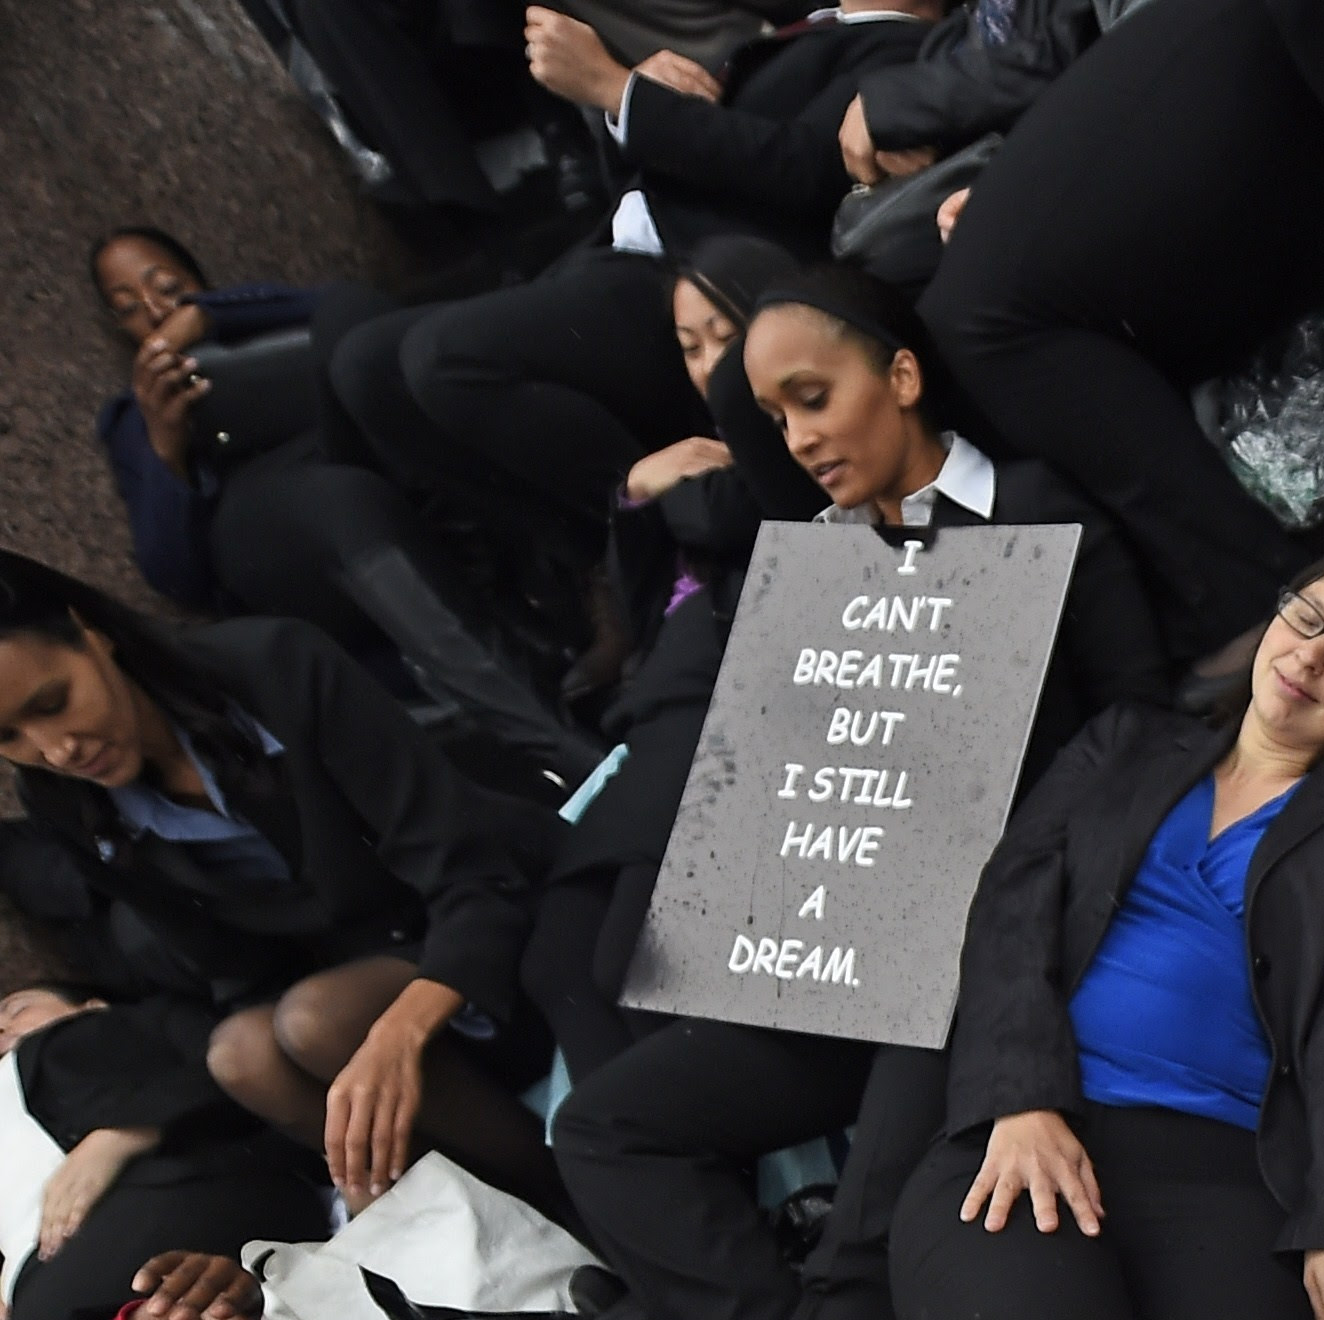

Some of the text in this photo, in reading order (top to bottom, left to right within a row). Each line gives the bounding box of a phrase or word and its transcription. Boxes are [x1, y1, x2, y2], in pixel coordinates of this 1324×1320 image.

[896, 540, 924, 575] I
[842, 595, 953, 632] CAN'T
[793, 648, 963, 696] BREATHE,
[826, 707, 905, 746] BUT
[777, 763, 912, 808] I STILL
[780, 821, 884, 866] HAVE
[798, 885, 825, 919] A
[728, 934, 860, 986] DREAM.
